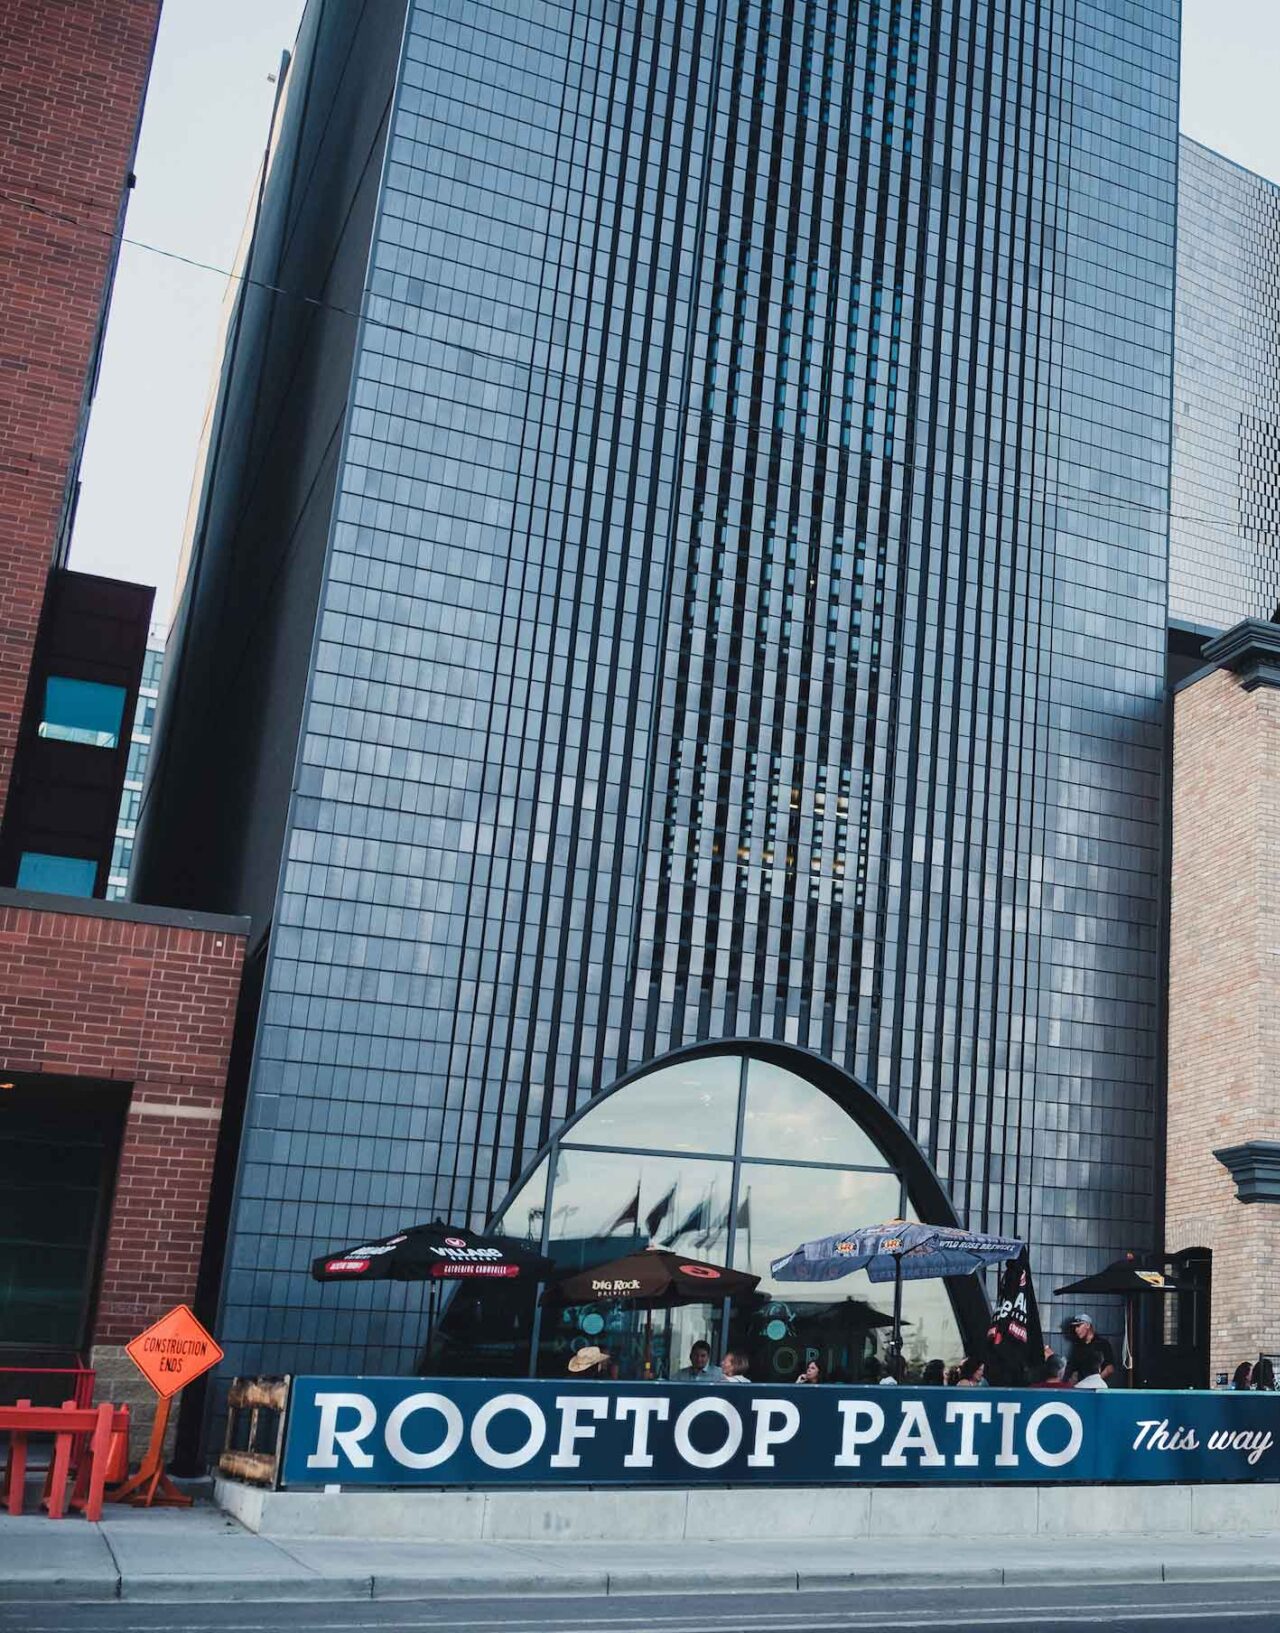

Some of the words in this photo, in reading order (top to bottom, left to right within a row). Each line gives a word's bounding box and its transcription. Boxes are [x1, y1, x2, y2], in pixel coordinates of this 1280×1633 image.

[429, 1246, 504, 1258] VILLAGE
[959, 1241, 980, 1250] ROSE
[143, 1337, 208, 1357] CONSTRUCTION
[159, 1356, 184, 1374] ENDS
[306, 1392, 801, 1469] ROOFTOP
[834, 1400, 1084, 1467] PATIO
[1132, 1418, 1200, 1451] This
[1206, 1430, 1274, 1466] way
